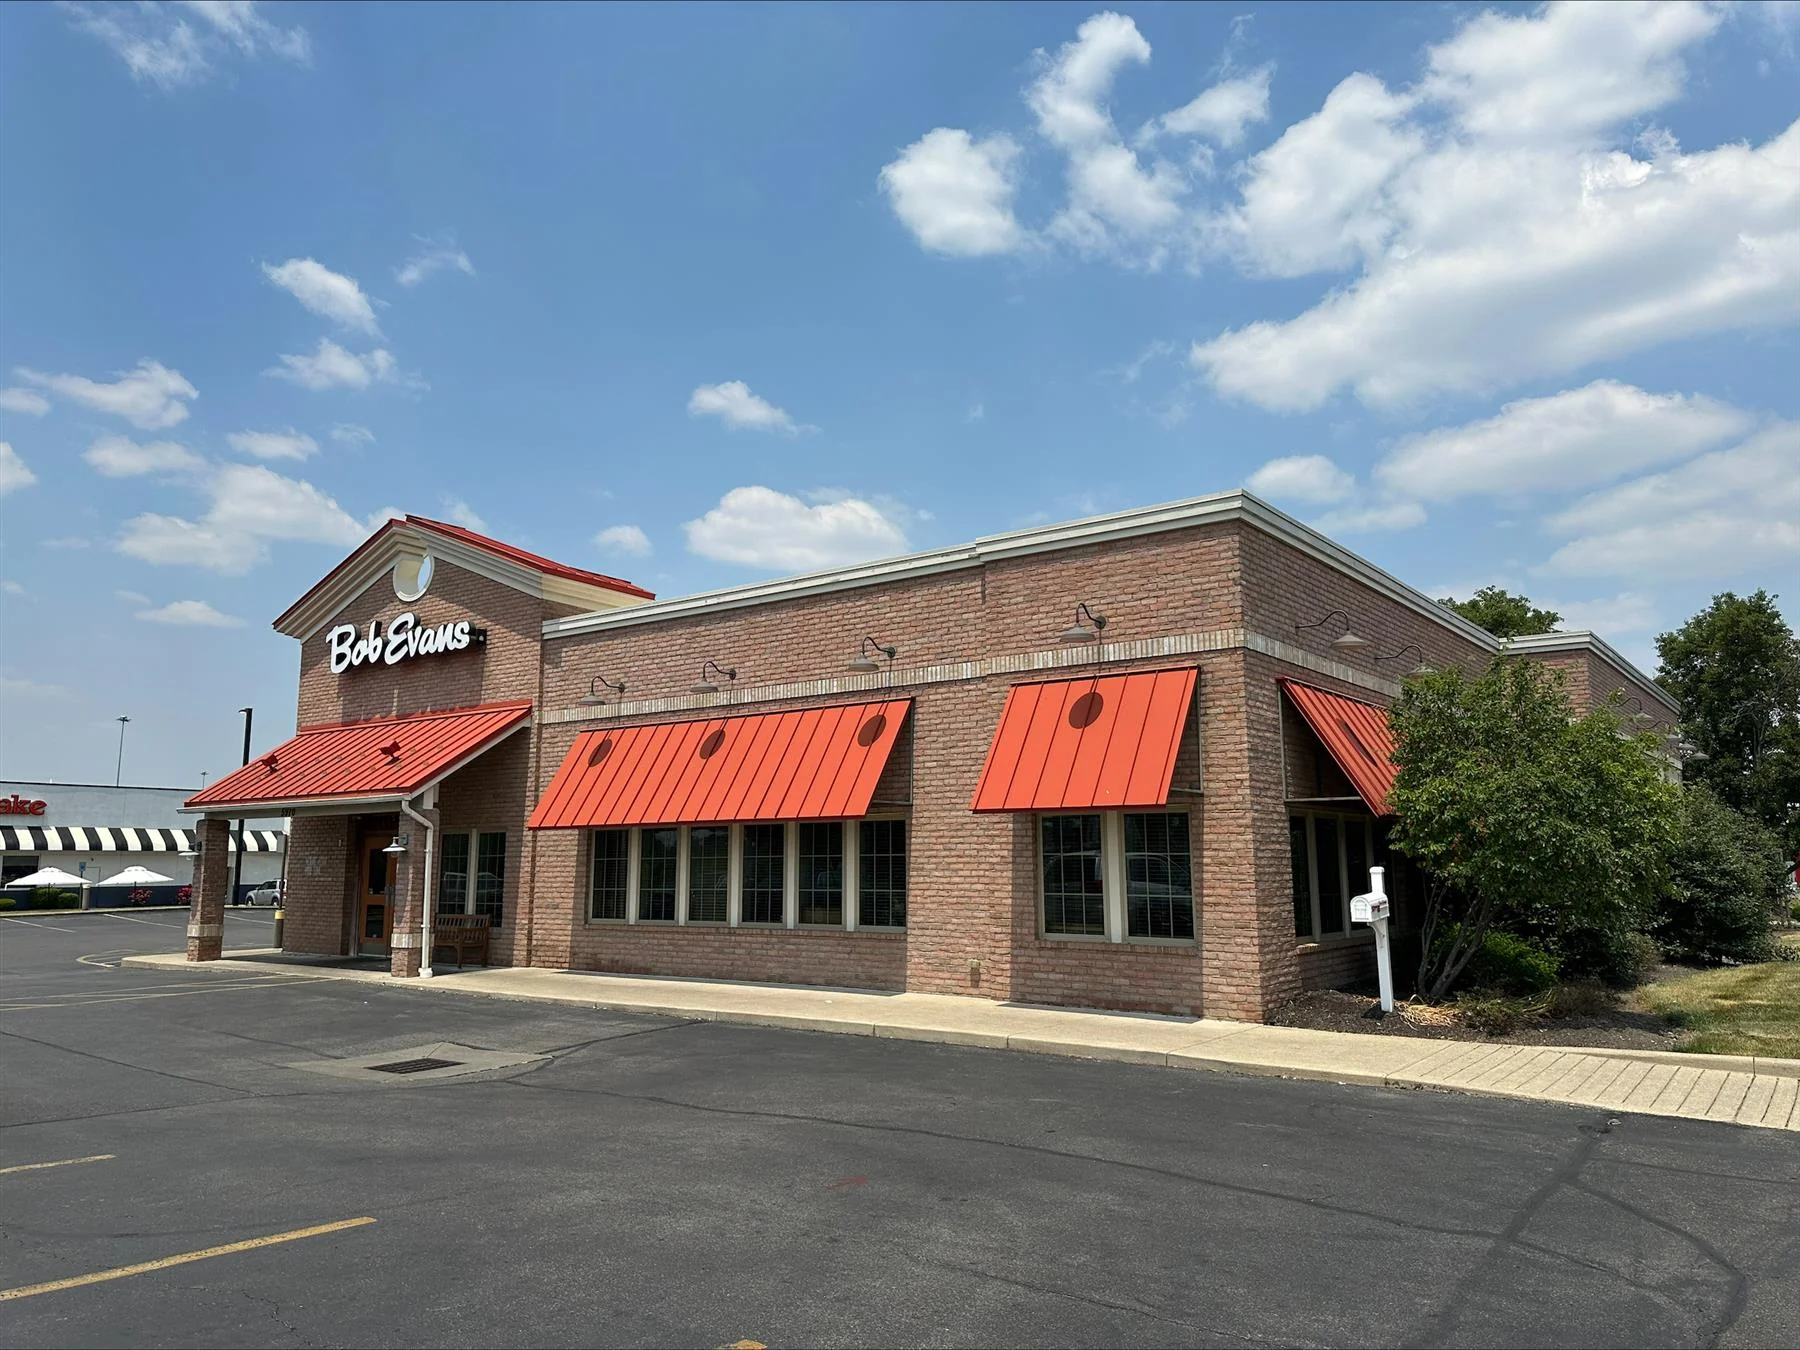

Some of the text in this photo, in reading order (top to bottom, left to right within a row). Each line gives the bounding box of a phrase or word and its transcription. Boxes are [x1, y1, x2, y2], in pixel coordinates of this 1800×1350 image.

[325, 612, 471, 674] Bob Evans
[0, 794, 48, 816] ake
